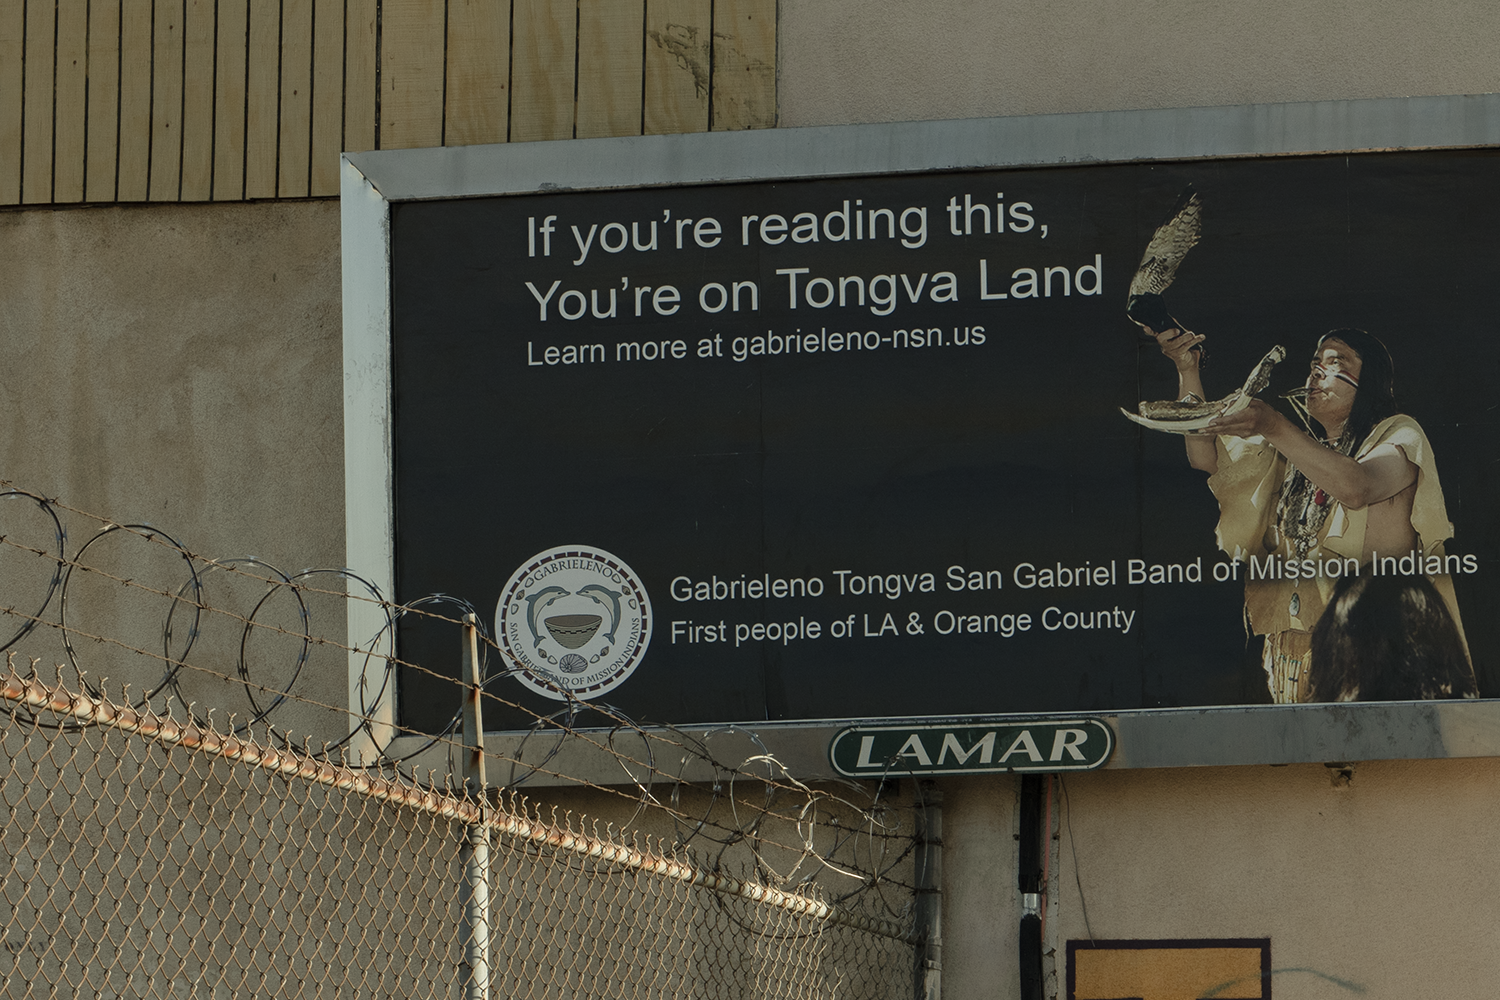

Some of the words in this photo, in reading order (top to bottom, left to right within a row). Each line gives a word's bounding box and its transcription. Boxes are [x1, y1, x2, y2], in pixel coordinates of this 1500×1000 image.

[526, 214, 558, 258] If
[742, 199, 928, 250] reading
[946, 191, 1049, 238] this,
[699, 282, 759, 313] on
[776, 266, 959, 316] Tongva
[980, 253, 1104, 307] Land
[527, 341, 605, 367] Learn
[617, 338, 688, 362] more
[696, 333, 723, 358] at
[732, 324, 987, 362] gabrieleno-nsn.us
[533, 559, 613, 582] GABRIELENO
[670, 572, 825, 603] Gabrieleno
[832, 570, 935, 600] Tongva
[946, 565, 1003, 592] San
[1013, 558, 1117, 589] Gabriel
[1128, 555, 1202, 586] Band
[1212, 554, 1243, 581] of
[1249, 551, 1361, 580] Mission
[1372, 549, 1478, 577] Indians
[671, 616, 727, 644] First
[735, 616, 822, 649] people
[830, 614, 856, 638] of
[864, 612, 899, 637] LA
[906, 611, 925, 636] &
[934, 608, 1032, 639] Orange
[1041, 603, 1136, 634] County
[509, 622, 520, 642] SAN
[571, 677, 585, 686] OF
[586, 658, 624, 684] MISSION
[622, 617, 640, 660] INDIANS
[855, 728, 1090, 769] LAMAR
